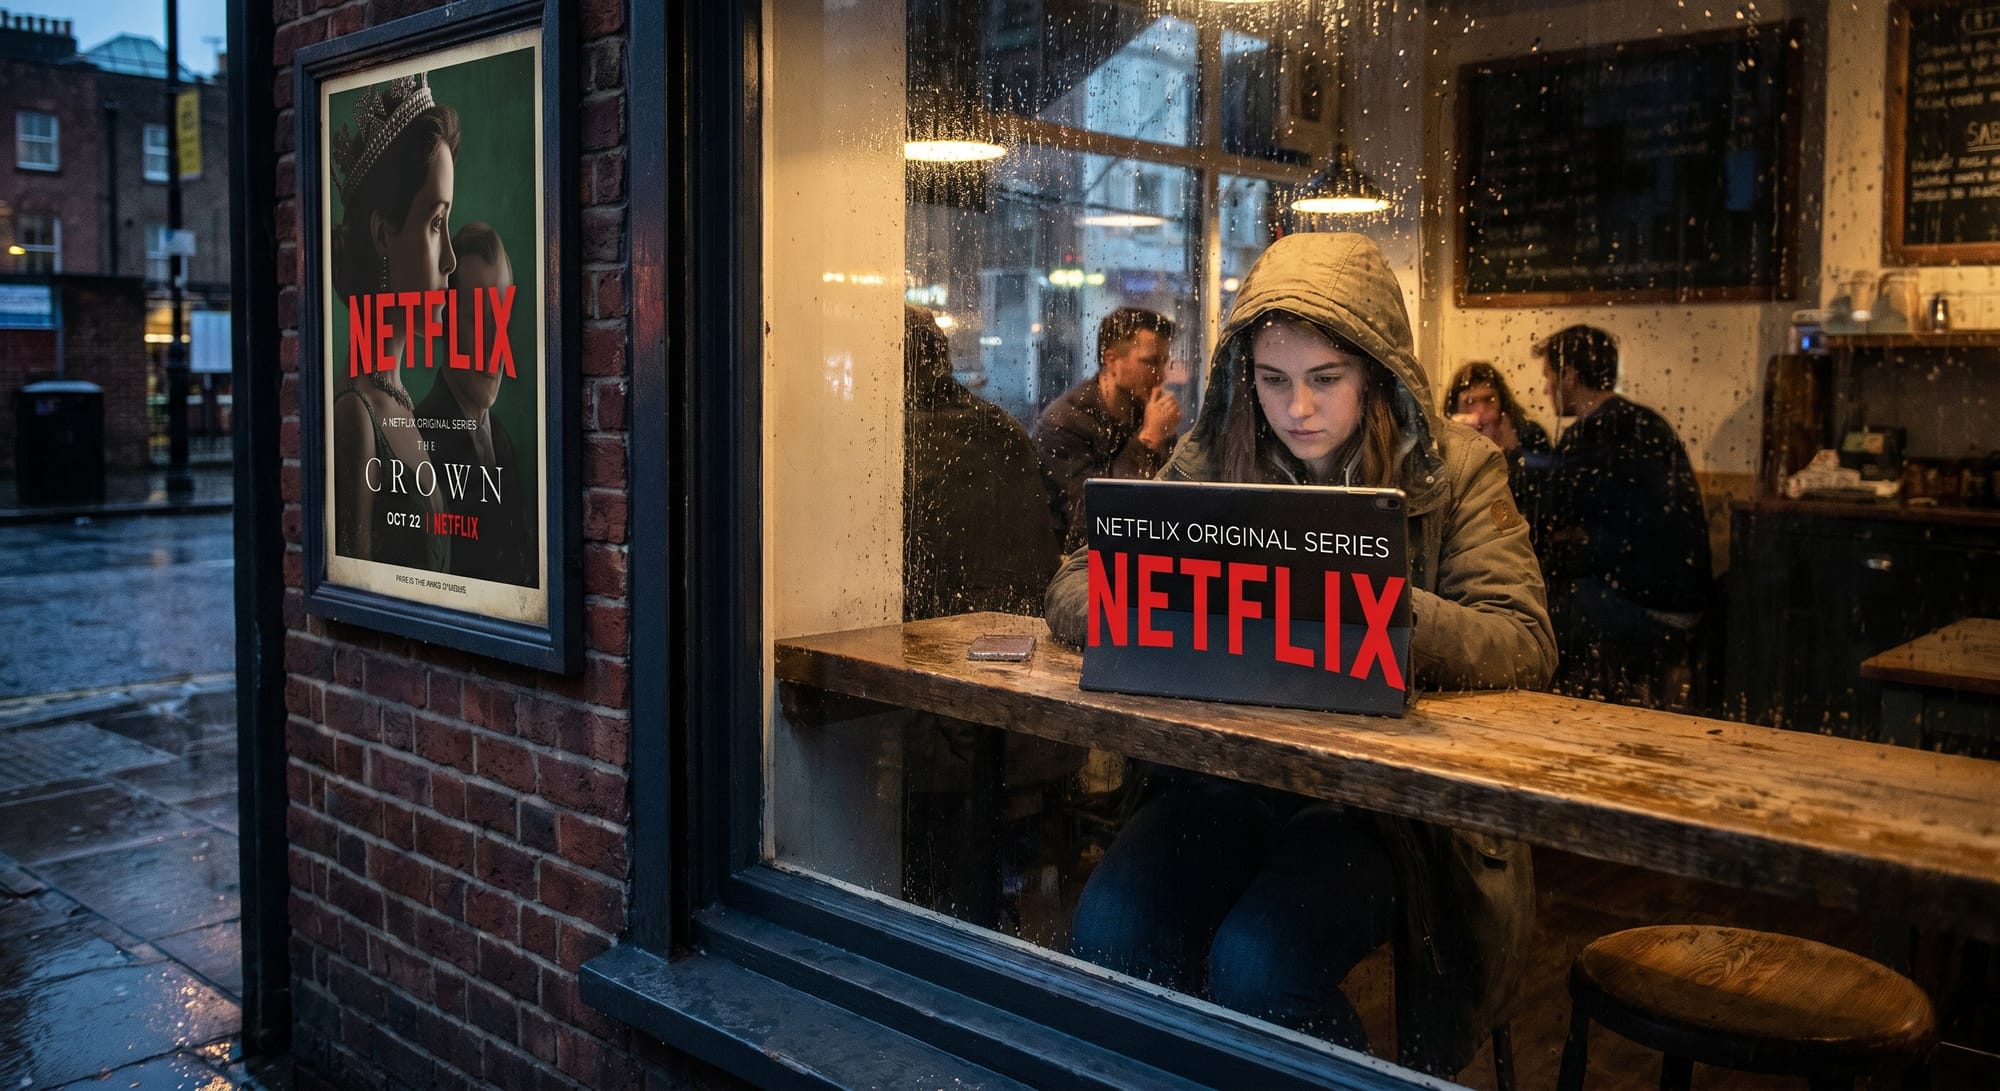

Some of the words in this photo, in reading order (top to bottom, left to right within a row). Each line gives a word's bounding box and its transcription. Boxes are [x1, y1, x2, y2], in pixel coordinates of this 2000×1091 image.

[348, 285, 518, 380] NETFLIX
[382, 418, 387, 427] A
[389, 417, 416, 428] NETFLIX
[416, 418, 451, 430] ORIGINAL
[451, 419, 477, 431] SERIES
[417, 440, 436, 452] THE
[365, 457, 504, 505] CROWN
[387, 511, 407, 527] OCT
[409, 514, 421, 528] 22
[433, 512, 479, 540] NETFLIX
[1096, 516, 1180, 541] NETFLIX
[1187, 523, 1297, 551] ORIGINAL
[1304, 531, 1390, 559] SERIES
[1087, 549, 1407, 692] NETFLIX
